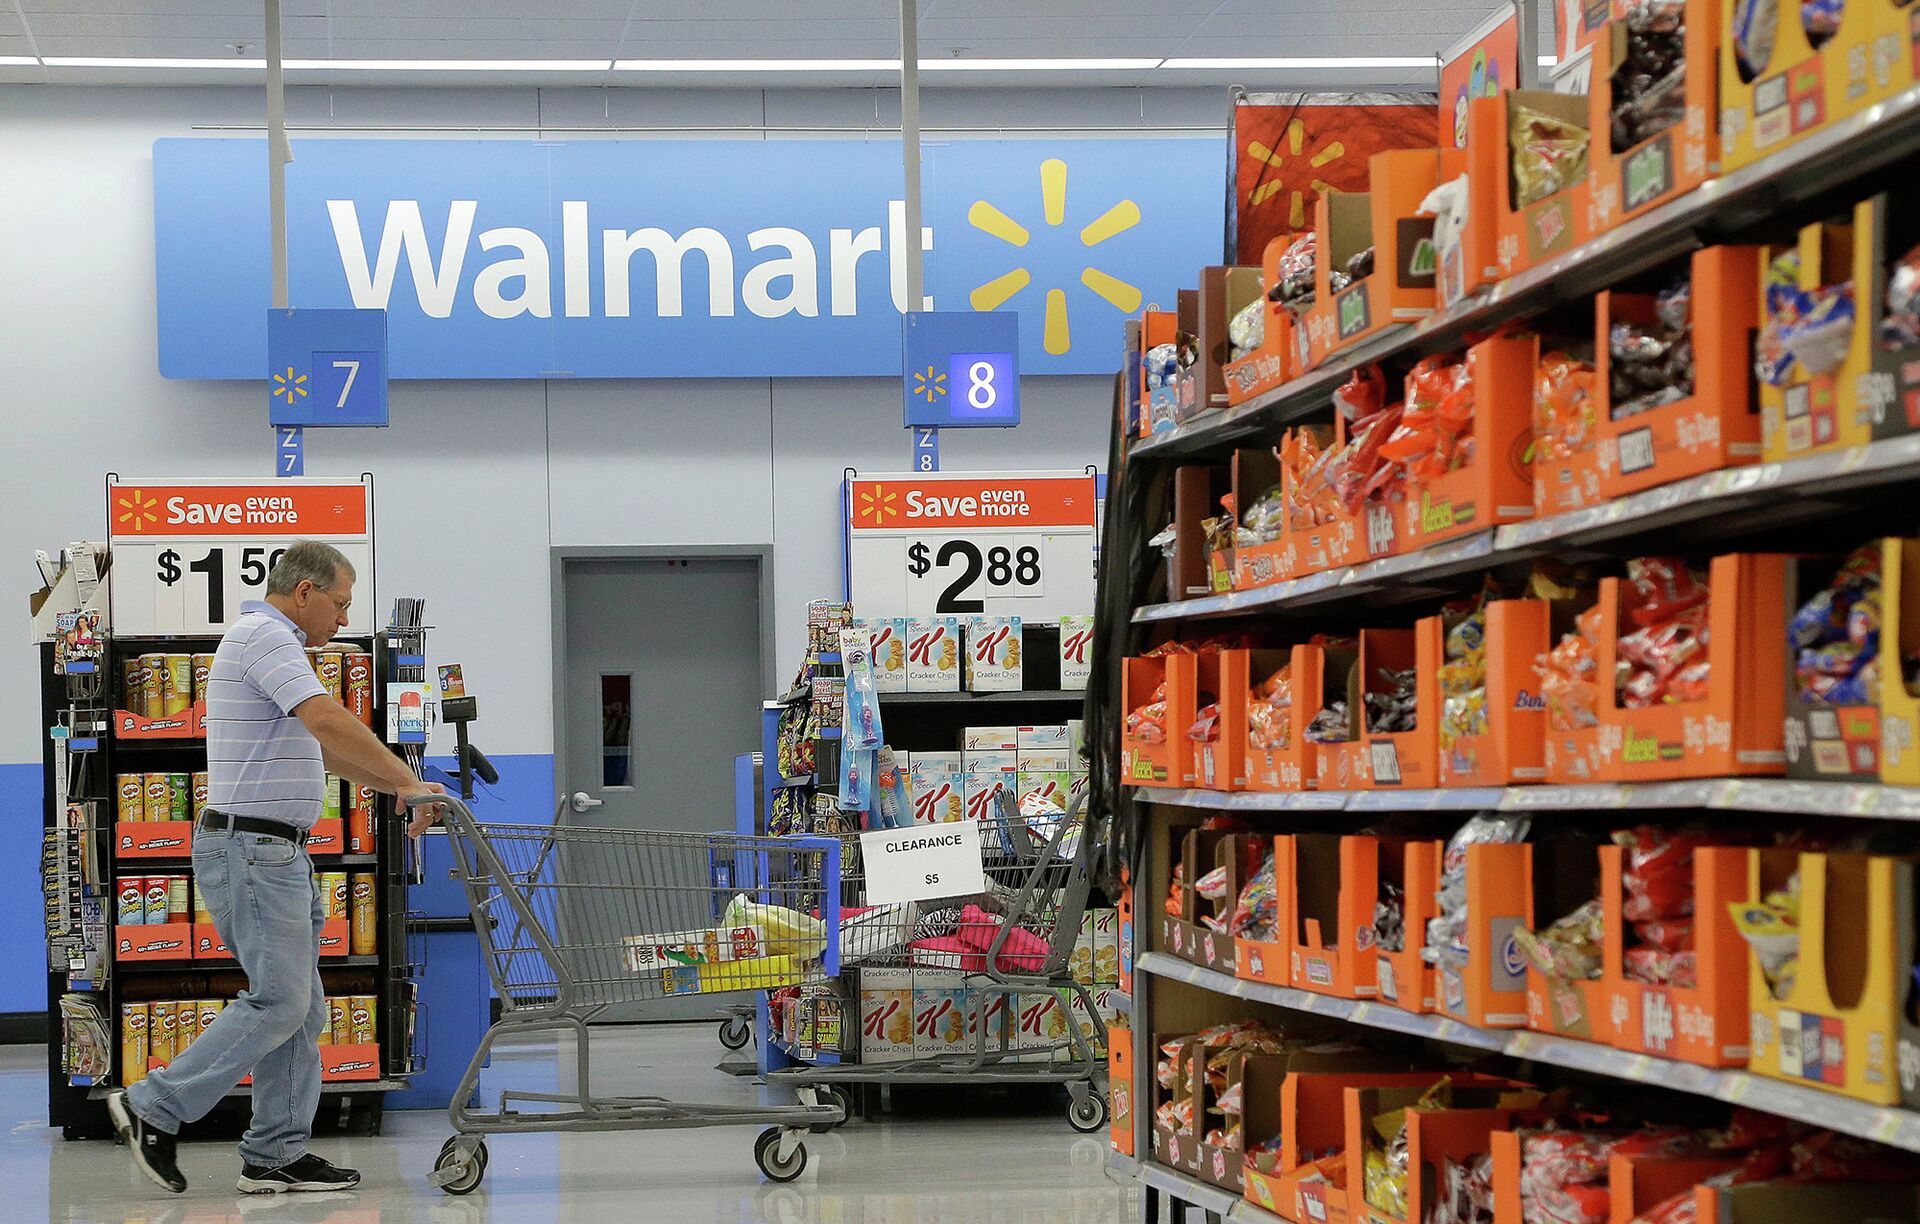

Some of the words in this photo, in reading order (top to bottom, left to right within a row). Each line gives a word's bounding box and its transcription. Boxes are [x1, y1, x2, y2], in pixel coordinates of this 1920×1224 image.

[326, 200, 934, 319] Walmart
[332, 361, 360, 408] 7
[967, 361, 997, 409] 8
[282, 429, 297, 447] Z
[919, 429, 933, 447] Z
[284, 455, 297, 471] 7
[920, 454, 932, 471] 8
[166, 497, 242, 524] Save
[246, 497, 293, 510] even
[906, 490, 977, 517] Save
[980, 490, 1025, 502] even
[981, 503, 1030, 516] more
[246, 510, 297, 523] more
[909, 627, 945, 666] K
[976, 626, 1010, 665] K
[910, 672, 936, 680] Cracker
[937, 672, 956, 681] Chips
[1002, 671, 1020, 679] Chips
[1064, 669, 1090, 677] Cracker
[389, 718, 430, 727] America
[914, 783, 951, 822] K
[885, 834, 962, 853] CLEARANCE
[925, 873, 940, 885] $5
[863, 969, 890, 977] Cracker
[916, 969, 942, 977] Cracker
[864, 1000, 899, 1040] K
[916, 999, 952, 1039] K
[864, 1045, 891, 1053] Cracker
[916, 1044, 943, 1052] Cracker
